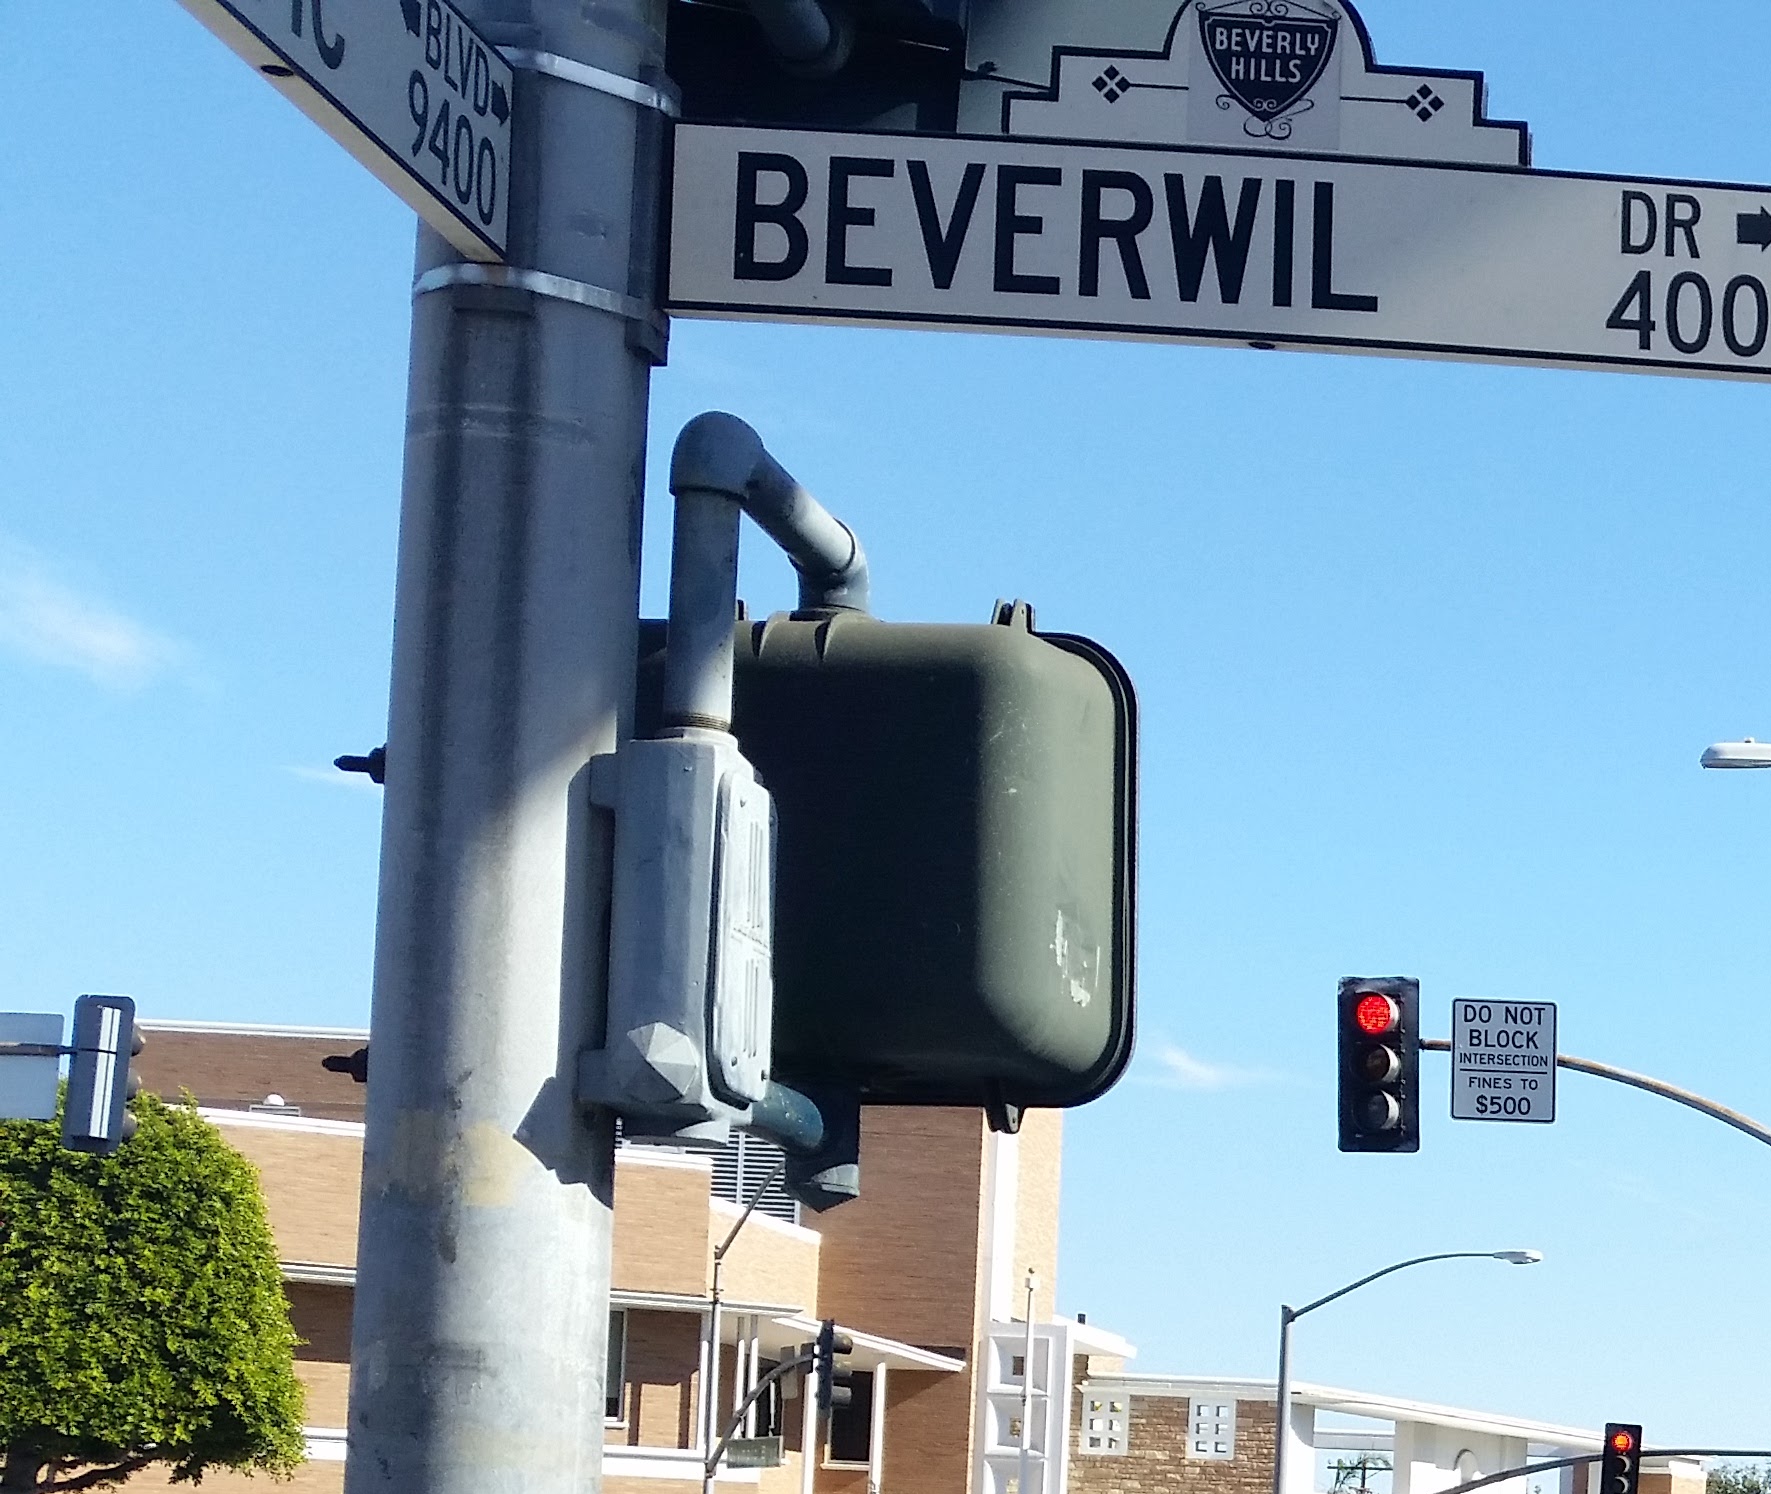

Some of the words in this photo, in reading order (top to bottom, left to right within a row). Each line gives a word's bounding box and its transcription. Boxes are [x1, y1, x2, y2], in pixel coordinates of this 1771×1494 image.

[1214, 27, 1320, 56] BEVERLY
[426, 0, 490, 117] BLVD
[1230, 56, 1302, 83] HILLS
[408, 69, 497, 227] 9400
[731, 150, 1380, 314] BEVERWIL
[1618, 190, 1703, 260] DR
[1604, 271, 1771, 358] 400
[1463, 1004, 1492, 1024] DO
[1504, 1006, 1546, 1026] NOT
[1468, 1029, 1540, 1050] BLOCK
[1459, 1052, 1549, 1068] INTERSECTION
[1468, 1076, 1512, 1090] FINES
[1520, 1078, 1539, 1091] TO
[1475, 1094, 1532, 1116] $500
